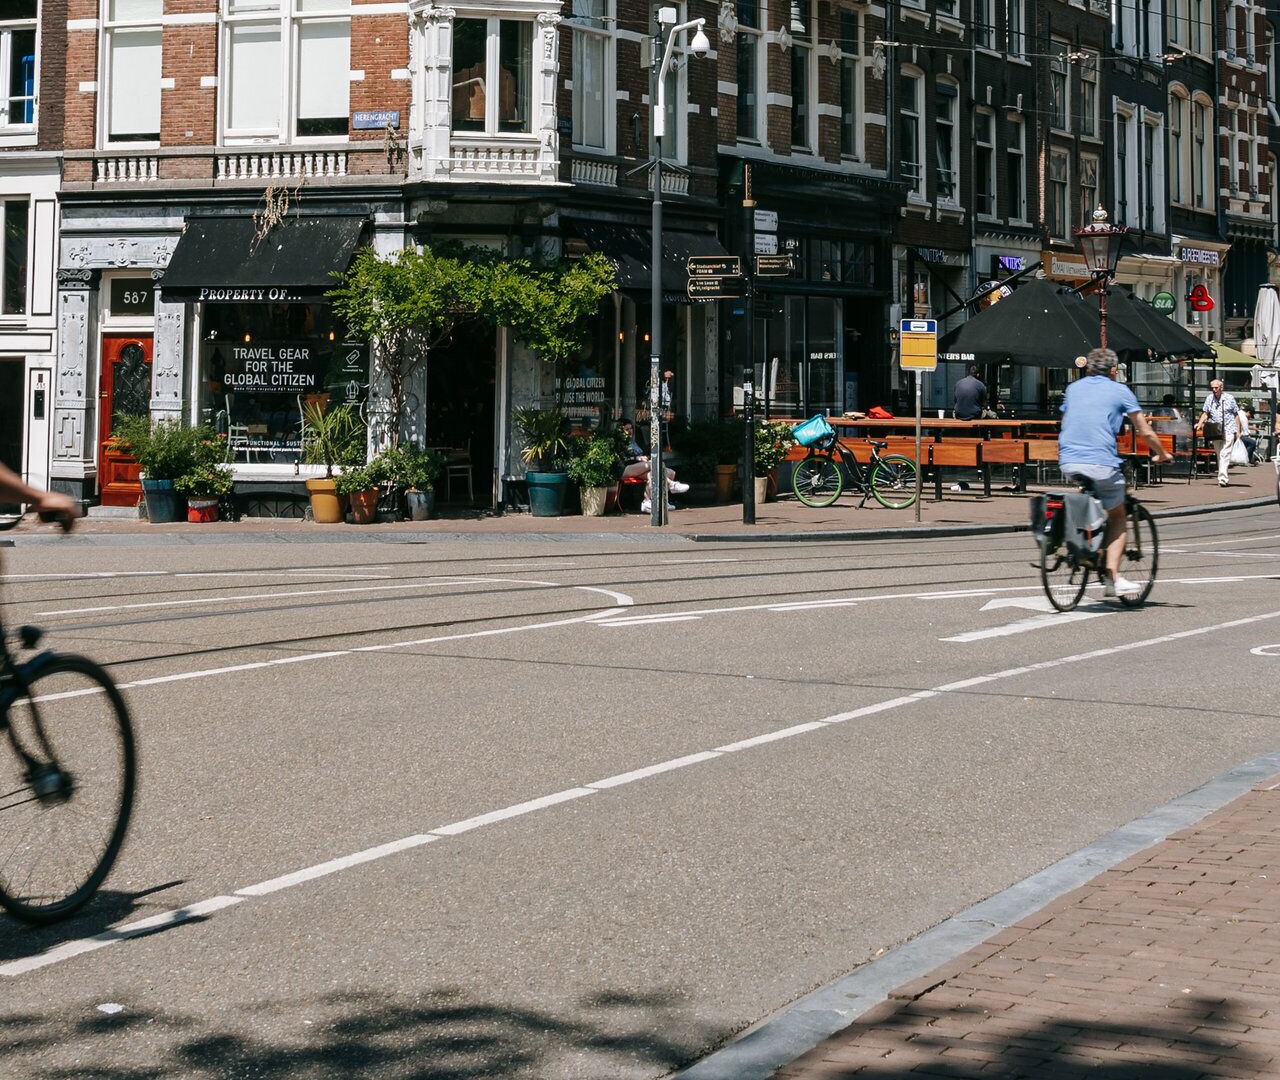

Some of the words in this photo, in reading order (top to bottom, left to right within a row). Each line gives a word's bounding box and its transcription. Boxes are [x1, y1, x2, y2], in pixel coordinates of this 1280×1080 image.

[355, 113, 397, 121] HERENGRACHT
[123, 291, 148, 304] 587
[199, 288, 265, 301] PROPERTY
[1154, 300, 1174, 309] SLA.
[233, 348, 276, 360] TRAVEL
[278, 348, 310, 360] GEAR
[961, 353, 975, 361] BAR
[245, 360, 268, 373] FOR
[271, 361, 294, 373] THE
[223, 373, 268, 386] GLOBAL
[271, 374, 315, 387] CITIZEN
[565, 377, 586, 389] GLOBAL
[586, 377, 606, 389] CITIZEN
[586, 391, 605, 402] WORLD
